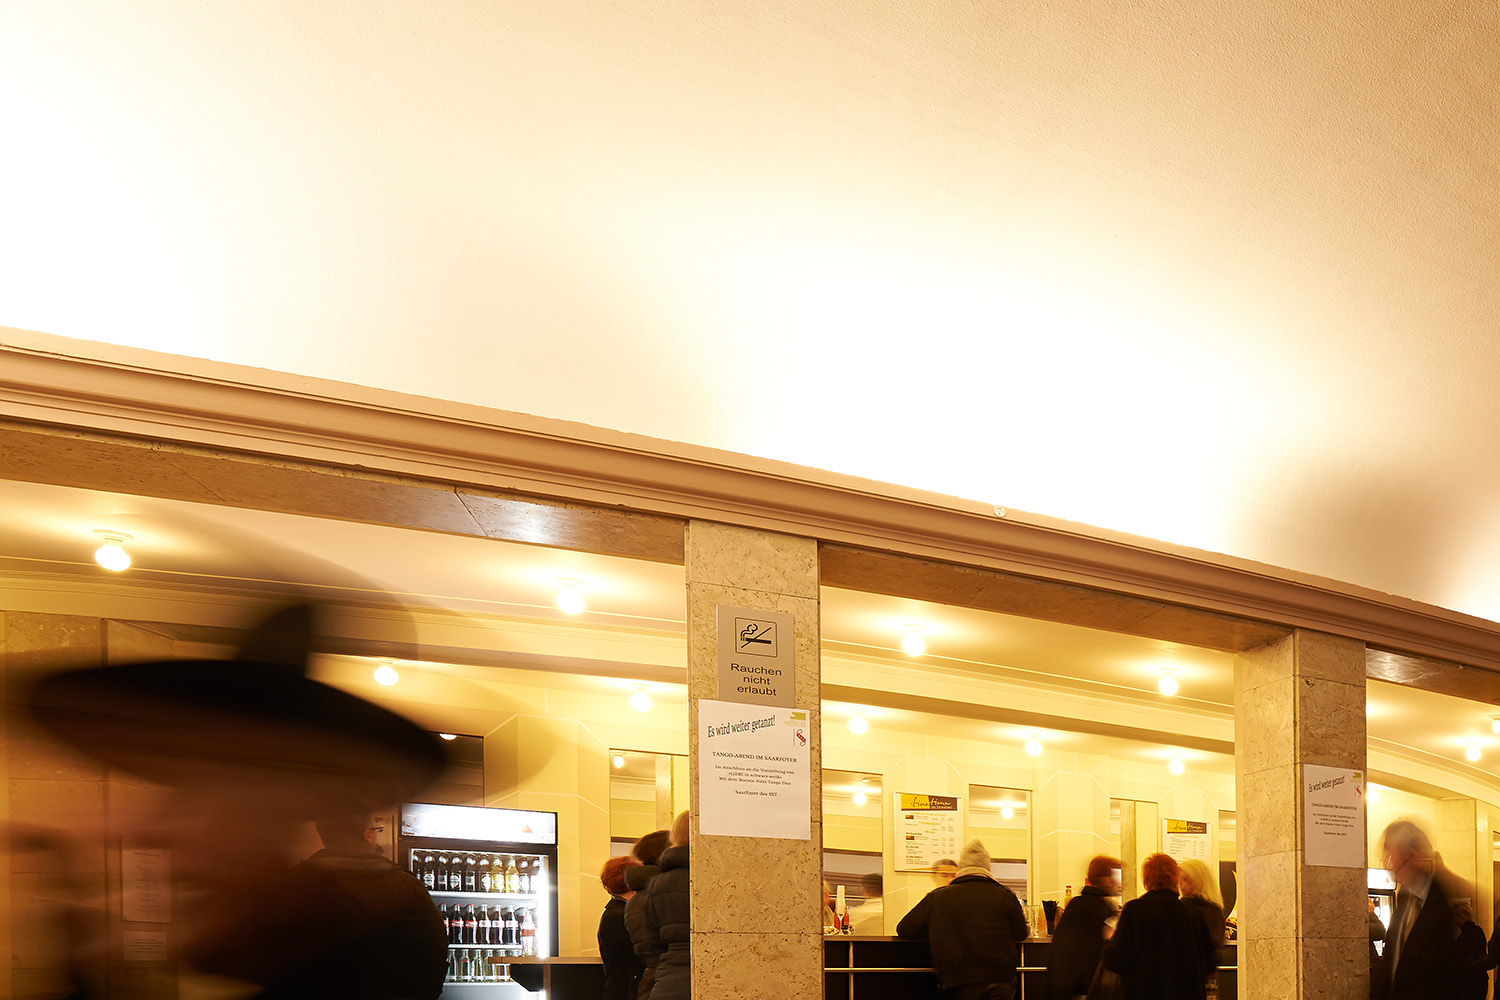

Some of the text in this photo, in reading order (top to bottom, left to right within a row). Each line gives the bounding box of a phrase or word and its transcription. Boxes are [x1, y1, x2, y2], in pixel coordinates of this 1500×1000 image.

[730, 662, 782, 676] Rauchen
[743, 675, 771, 685] nicht
[736, 685, 777, 696] erlaubt
[707, 725, 715, 737] Es
[715, 722, 730, 735] wird
[730, 719, 750, 733] weiter
[751, 714, 776, 733] getanzt!
[711, 751, 755, 760] TANGO-ABEND
[764, 755, 798, 763] SAARFOYER
